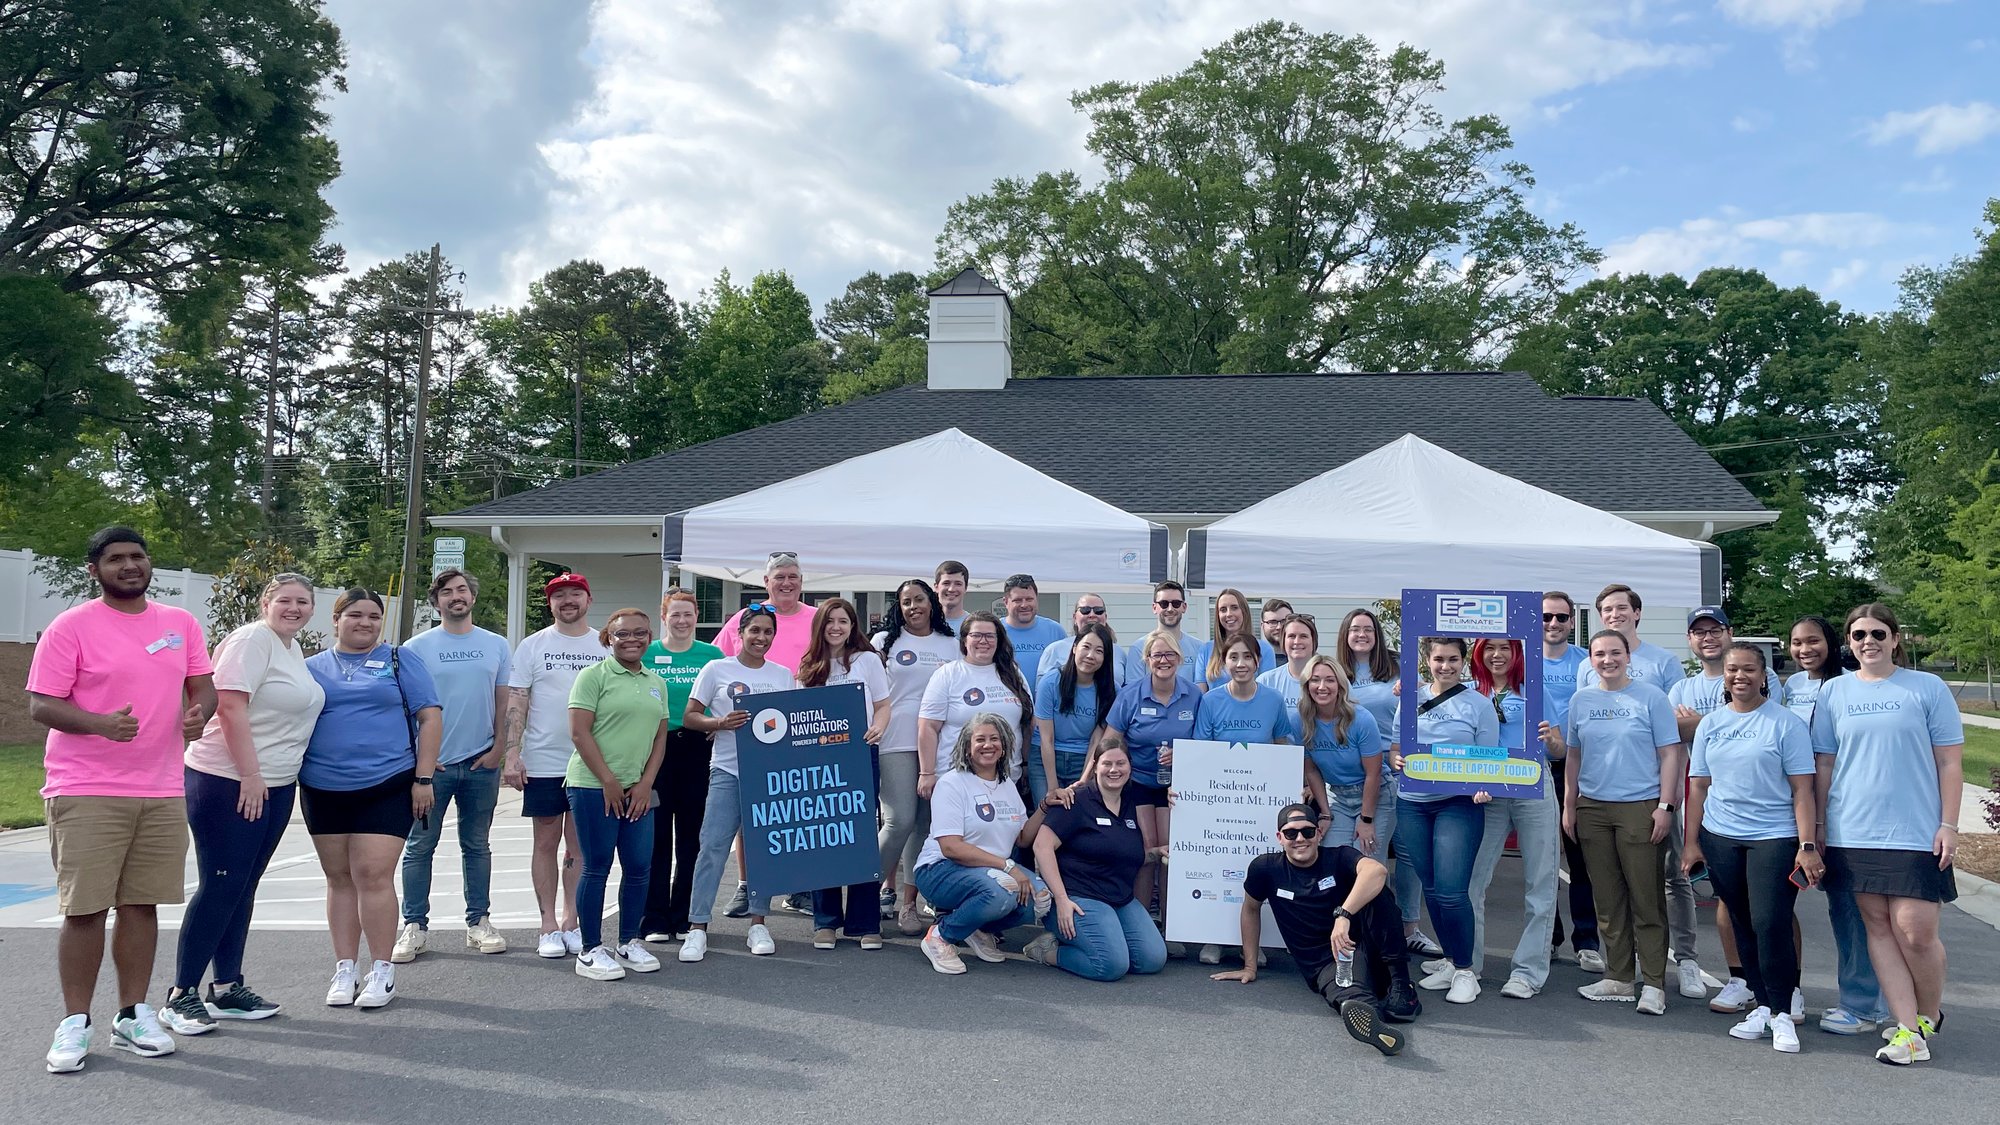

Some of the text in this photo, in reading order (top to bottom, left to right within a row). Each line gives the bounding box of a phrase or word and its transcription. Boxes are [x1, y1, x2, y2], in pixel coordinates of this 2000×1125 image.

[1441, 598, 1503, 617] E2D
[439, 650, 484, 661] BARINGS
[1542, 674, 1577, 683] ARINGS
[1589, 708, 1631, 717] BARINGS
[1847, 700, 1901, 714] BARINGS
[790, 709, 827, 724] DIGITAL
[791, 719, 849, 736] NAVIGATORS
[1436, 746, 1504, 757] Thank you BARINGS
[1412, 760, 1429, 772] GOT
[1432, 761, 1438, 773] A
[1441, 761, 1462, 774] FREE
[1466, 763, 1500, 776] LAPTOP
[1504, 764, 1537, 778] TODAY!
[767, 764, 848, 796] DIGITAL
[1209, 779, 1267, 792] Residents of
[1175, 791, 1231, 806] Abbington
[1233, 795, 1243, 804] at
[1247, 795, 1265, 806] Mt.
[751, 789, 866, 828] NAVIGATOR
[768, 820, 855, 855] STATION
[1203, 829, 1268, 842] Residentes de
[1173, 841, 1229, 857] Abbington
[1231, 845, 1241, 855] at
[1185, 871, 1213, 879] BARINGS
